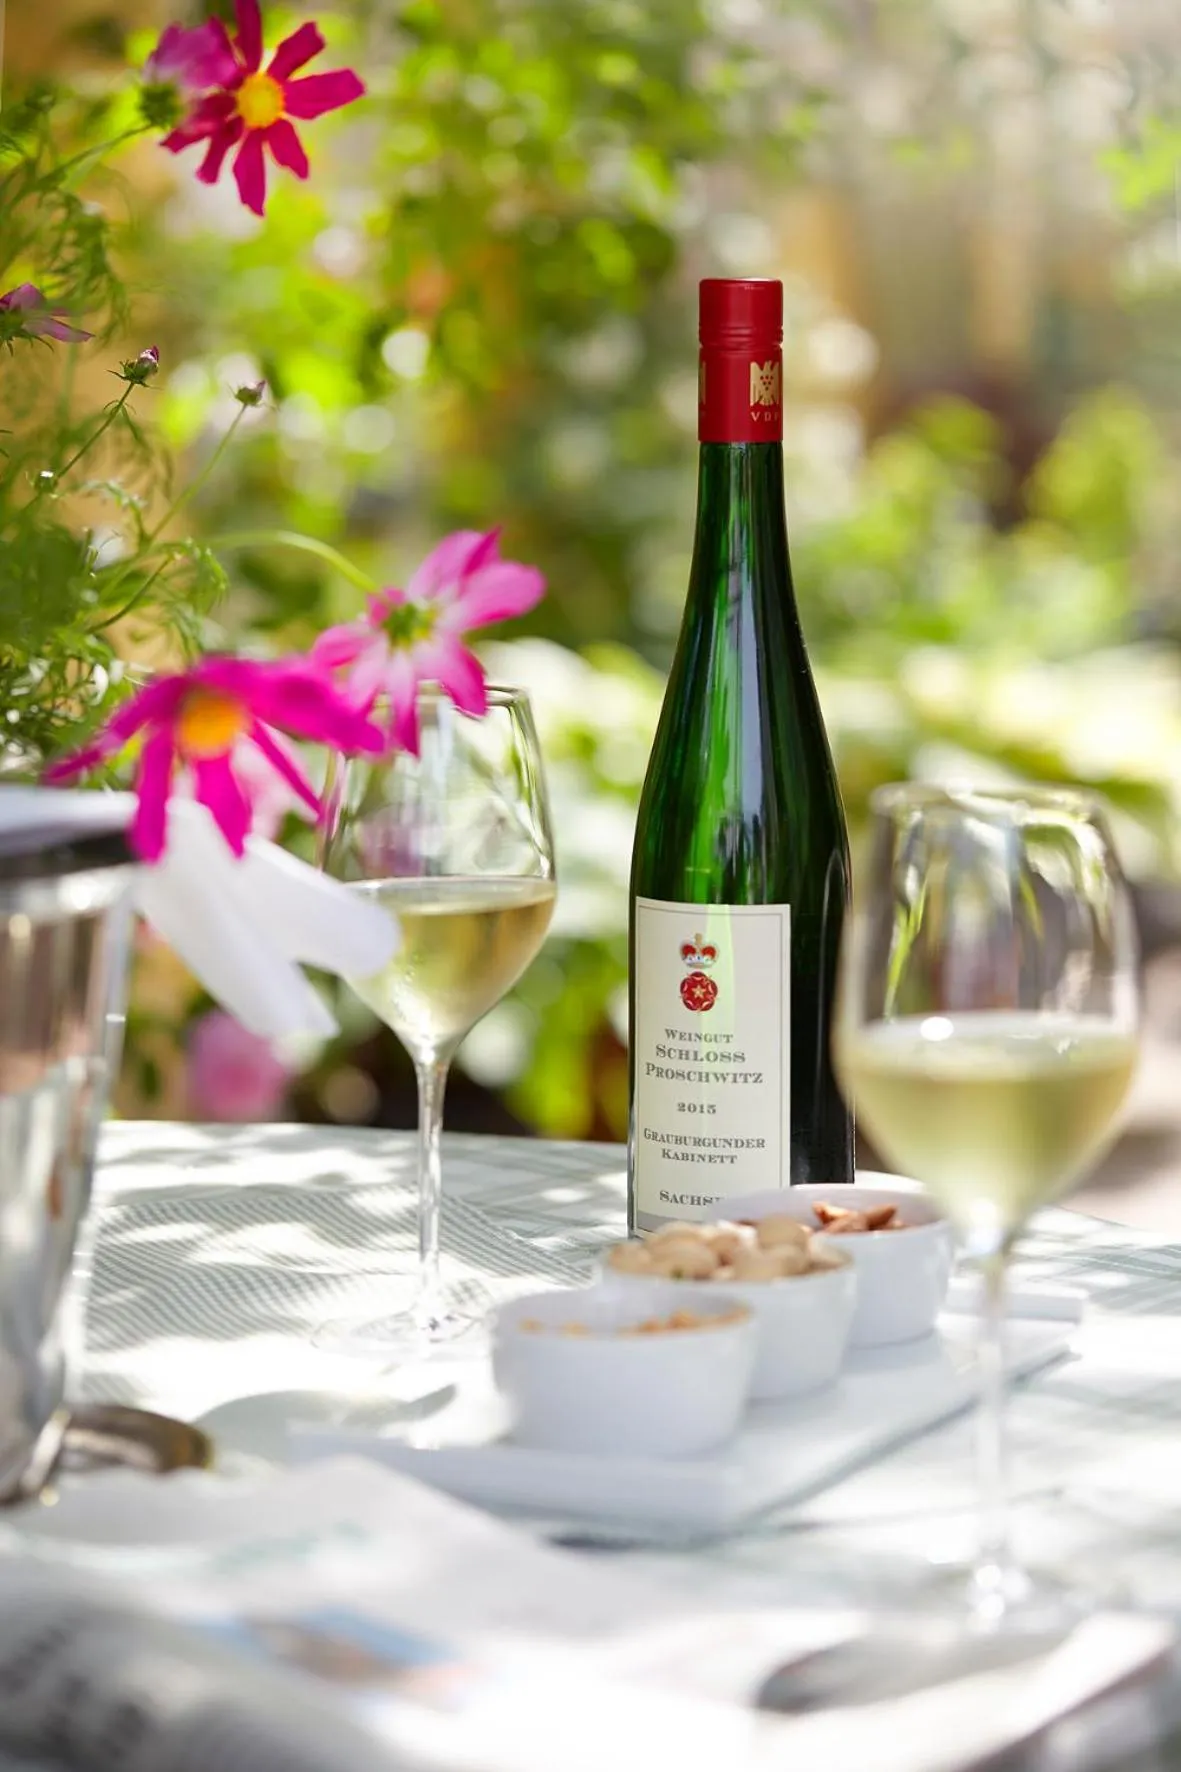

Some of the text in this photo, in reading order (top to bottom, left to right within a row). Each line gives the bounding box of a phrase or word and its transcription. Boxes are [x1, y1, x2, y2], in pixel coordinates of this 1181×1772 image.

[655, 1043, 746, 1063] SCHLOSS
[645, 1062, 764, 1084] PROSCHWITZ
[677, 1102, 717, 1115] 2015
[643, 1127, 766, 1149] GRAUBURGUNDER
[661, 1148, 738, 1164] KABINETT
[659, 1189, 722, 1206] SACHS
